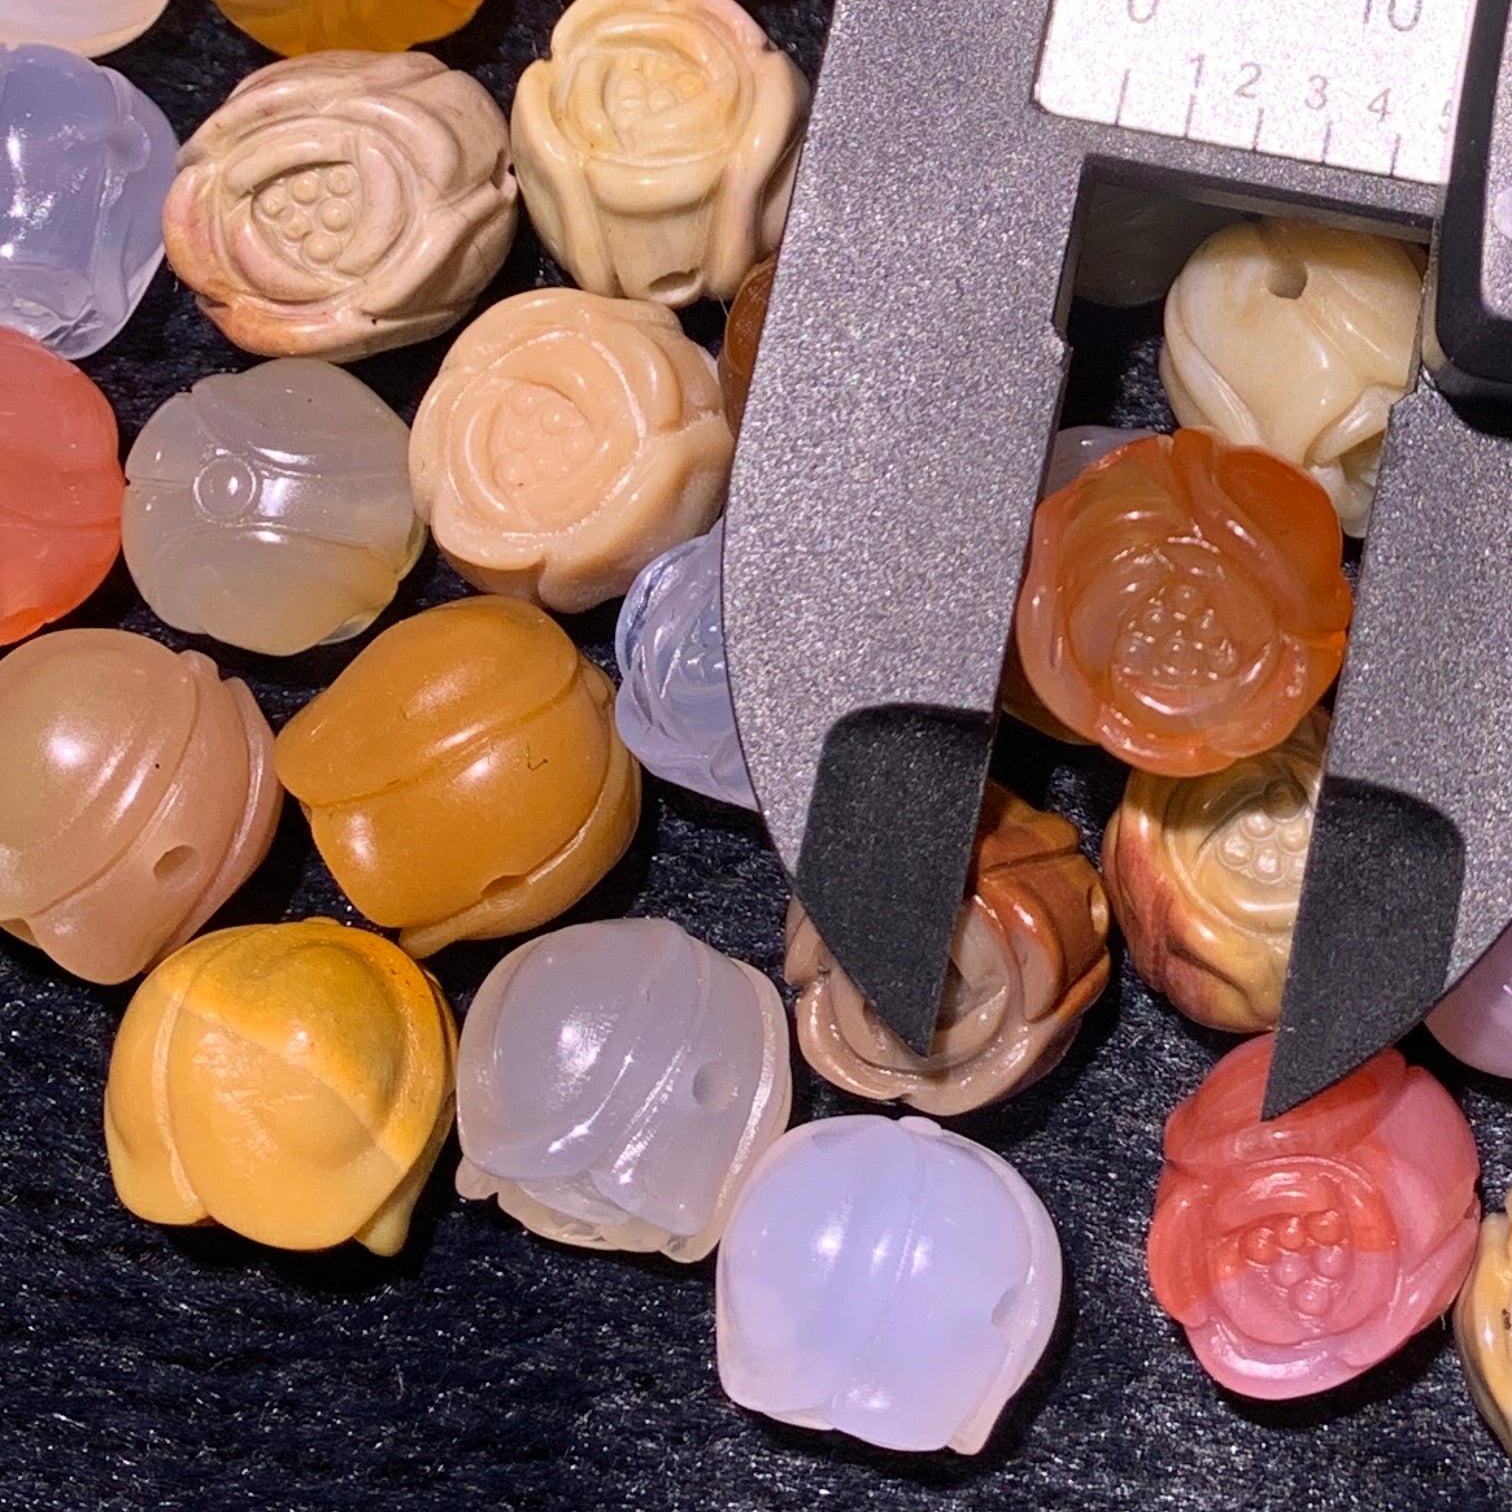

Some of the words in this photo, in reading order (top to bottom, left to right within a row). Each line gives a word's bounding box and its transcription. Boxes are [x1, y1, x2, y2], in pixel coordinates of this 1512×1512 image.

[1234, 63, 1263, 99] 2
[1304, 75, 1329, 110] 3
[1367, 88, 1392, 123] 4
